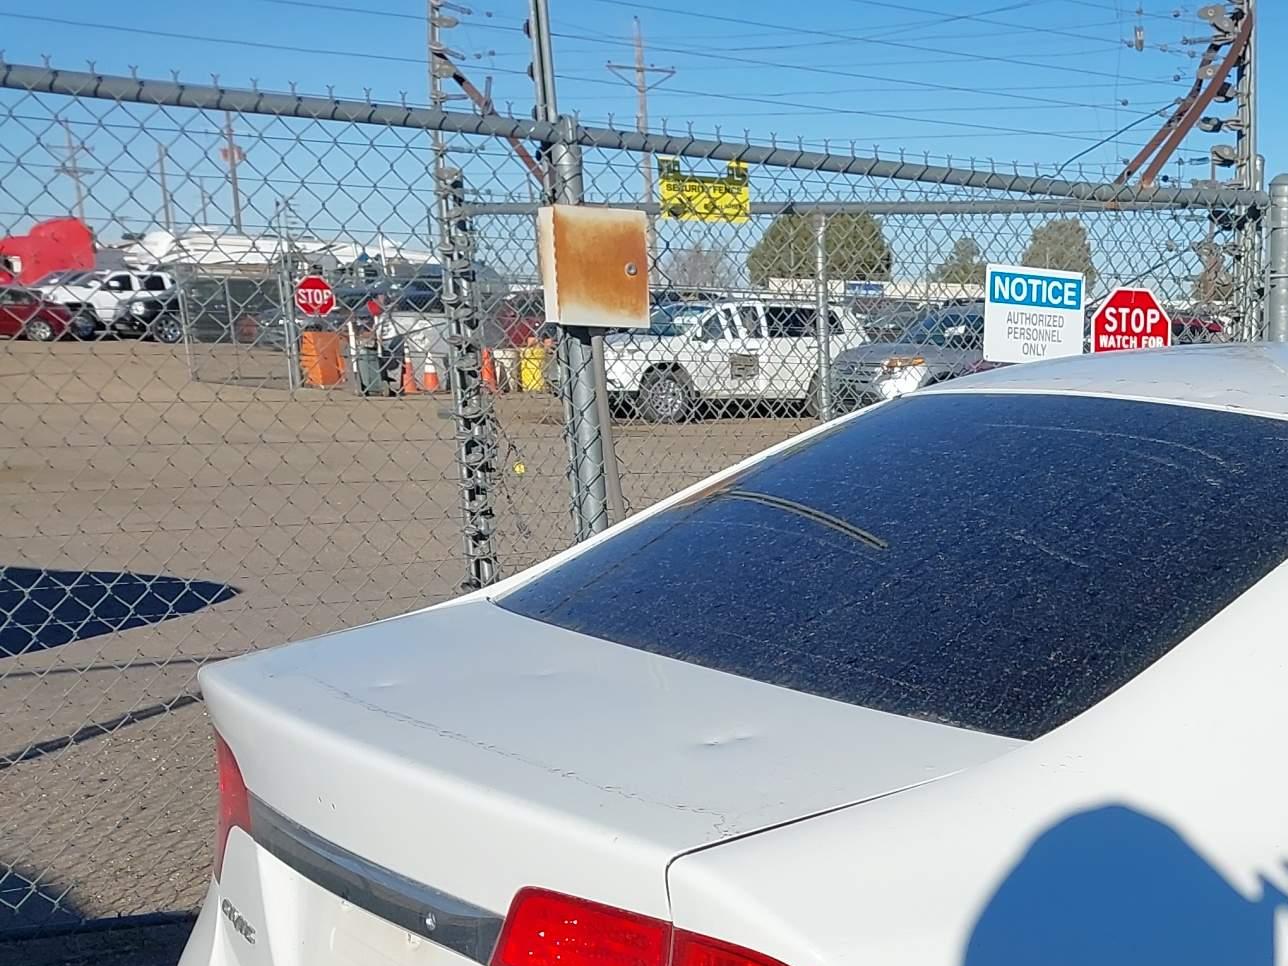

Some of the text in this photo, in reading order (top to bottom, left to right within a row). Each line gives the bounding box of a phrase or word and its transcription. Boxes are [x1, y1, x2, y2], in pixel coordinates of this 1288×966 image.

[298, 288, 332, 304] STOP
[994, 275, 1077, 306] NOTICE
[1006, 311, 1065, 328] AUTHORIZED
[1104, 306, 1161, 334] STOP
[1007, 328, 1063, 343] PERSONNEL
[1099, 335, 1164, 348] WATCH FOR
[1021, 342, 1048, 356] ONLY
